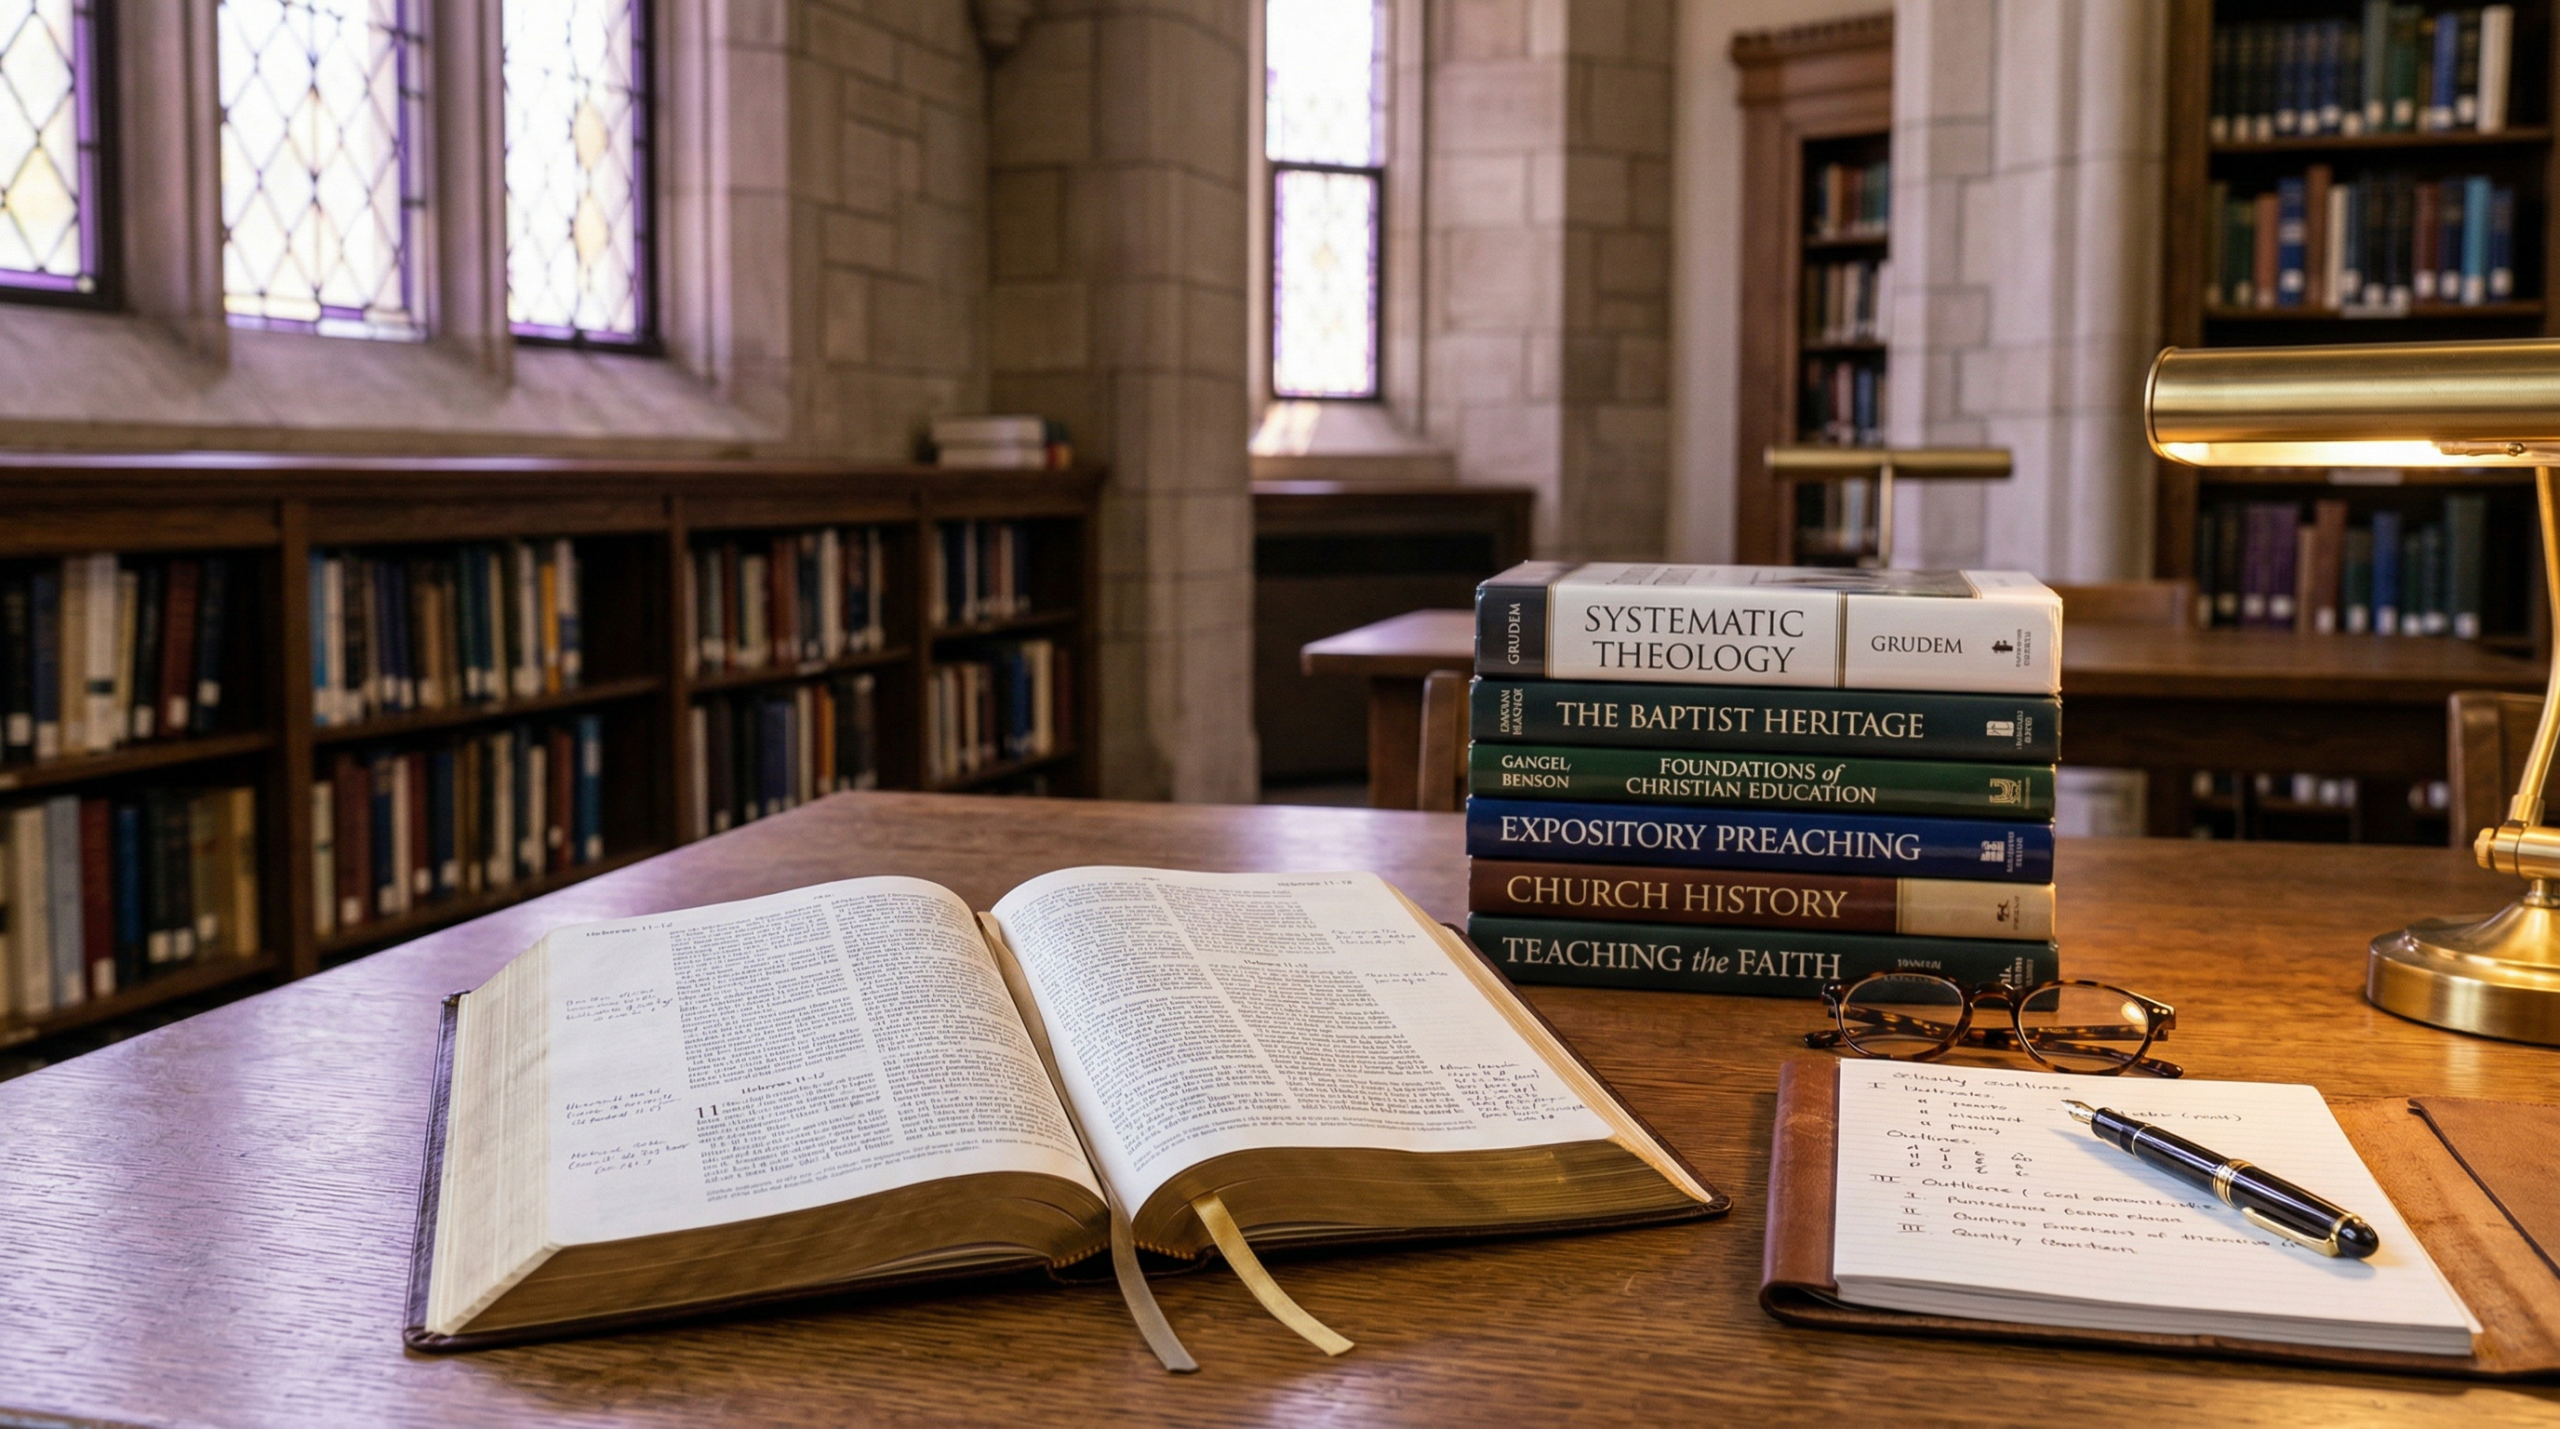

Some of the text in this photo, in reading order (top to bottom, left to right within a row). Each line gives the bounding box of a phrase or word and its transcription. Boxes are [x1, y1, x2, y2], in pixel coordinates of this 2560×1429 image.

[1507, 602, 1521, 665] GRUDEM
[1585, 605, 1804, 638] SYSTEMATIC
[1592, 641, 1795, 674] THEOLOGY
[1871, 635, 1963, 654] GRUDEM
[1556, 701, 1619, 728] THE
[1630, 704, 1755, 732] BAPTIST
[1765, 708, 1924, 739] HERITAGE
[1502, 773, 1569, 788] BENSON
[1660, 758, 1846, 784] FOUNDATIONS of
[1626, 776, 1877, 804] CHRISTIAN EDUCATION
[1501, 815, 1922, 861] EXPOSITORY PREACHING
[1507, 875, 1848, 918] CHURCH HISTORY
[1502, 936, 1841, 980] TEACHING the FAITH
